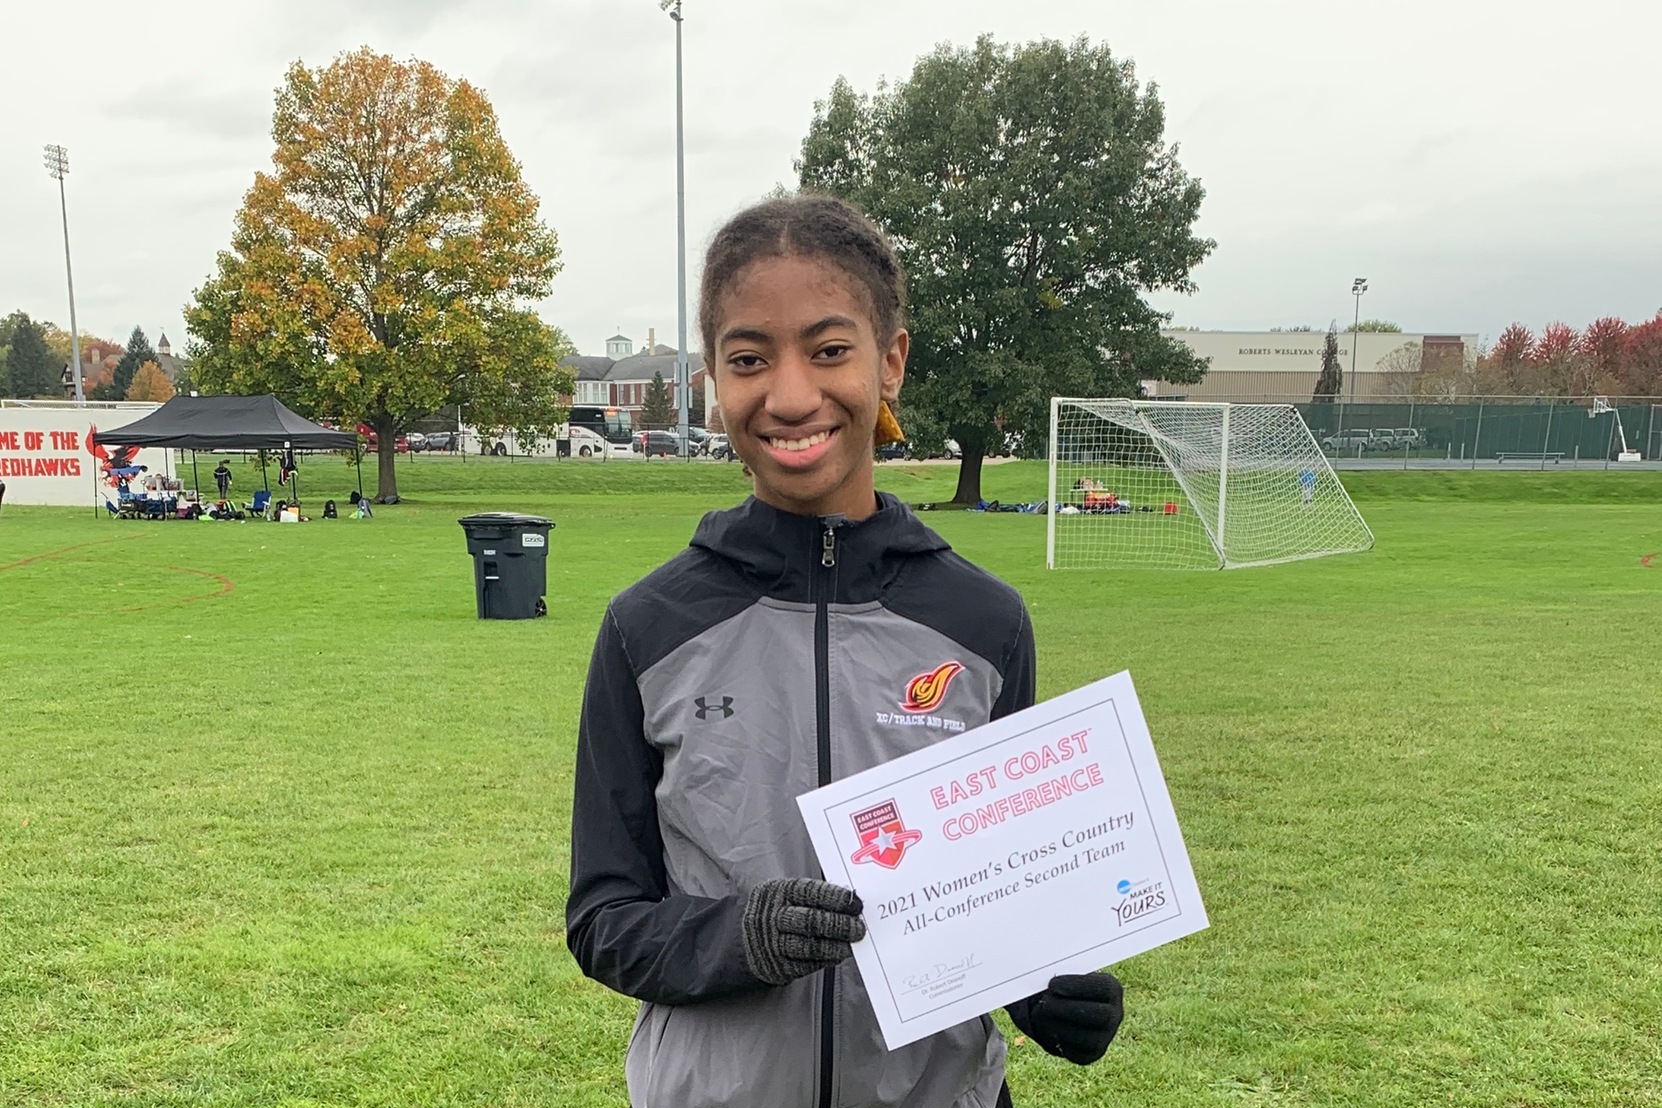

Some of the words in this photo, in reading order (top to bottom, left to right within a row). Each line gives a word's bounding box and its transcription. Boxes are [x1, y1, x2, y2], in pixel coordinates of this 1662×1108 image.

[24, 431, 44, 451] OF
[49, 431, 80, 450] THE
[0, 458, 81, 476] EDHAWKS
[926, 715, 942, 727] AND
[943, 719, 966, 732] FIELD
[930, 765, 997, 810] EAST
[1004, 729, 1089, 780] COAST
[942, 763, 1104, 841] CONFERENCE
[857, 813, 873, 823] EAST
[872, 805, 892, 818] COAST
[860, 813, 895, 830] CONFERENCE
[877, 892, 918, 920] 2021
[922, 862, 1003, 902] Women's
[1007, 842, 1057, 870] Cross
[1062, 811, 1134, 848] Country
[903, 881, 1020, 936] All-Conference
[1024, 854, 1080, 888] Second
[1082, 840, 1126, 865] Team
[1130, 885, 1153, 899] MAKE
[1154, 881, 1162, 891] IT
[1111, 891, 1166, 927] YOURS
